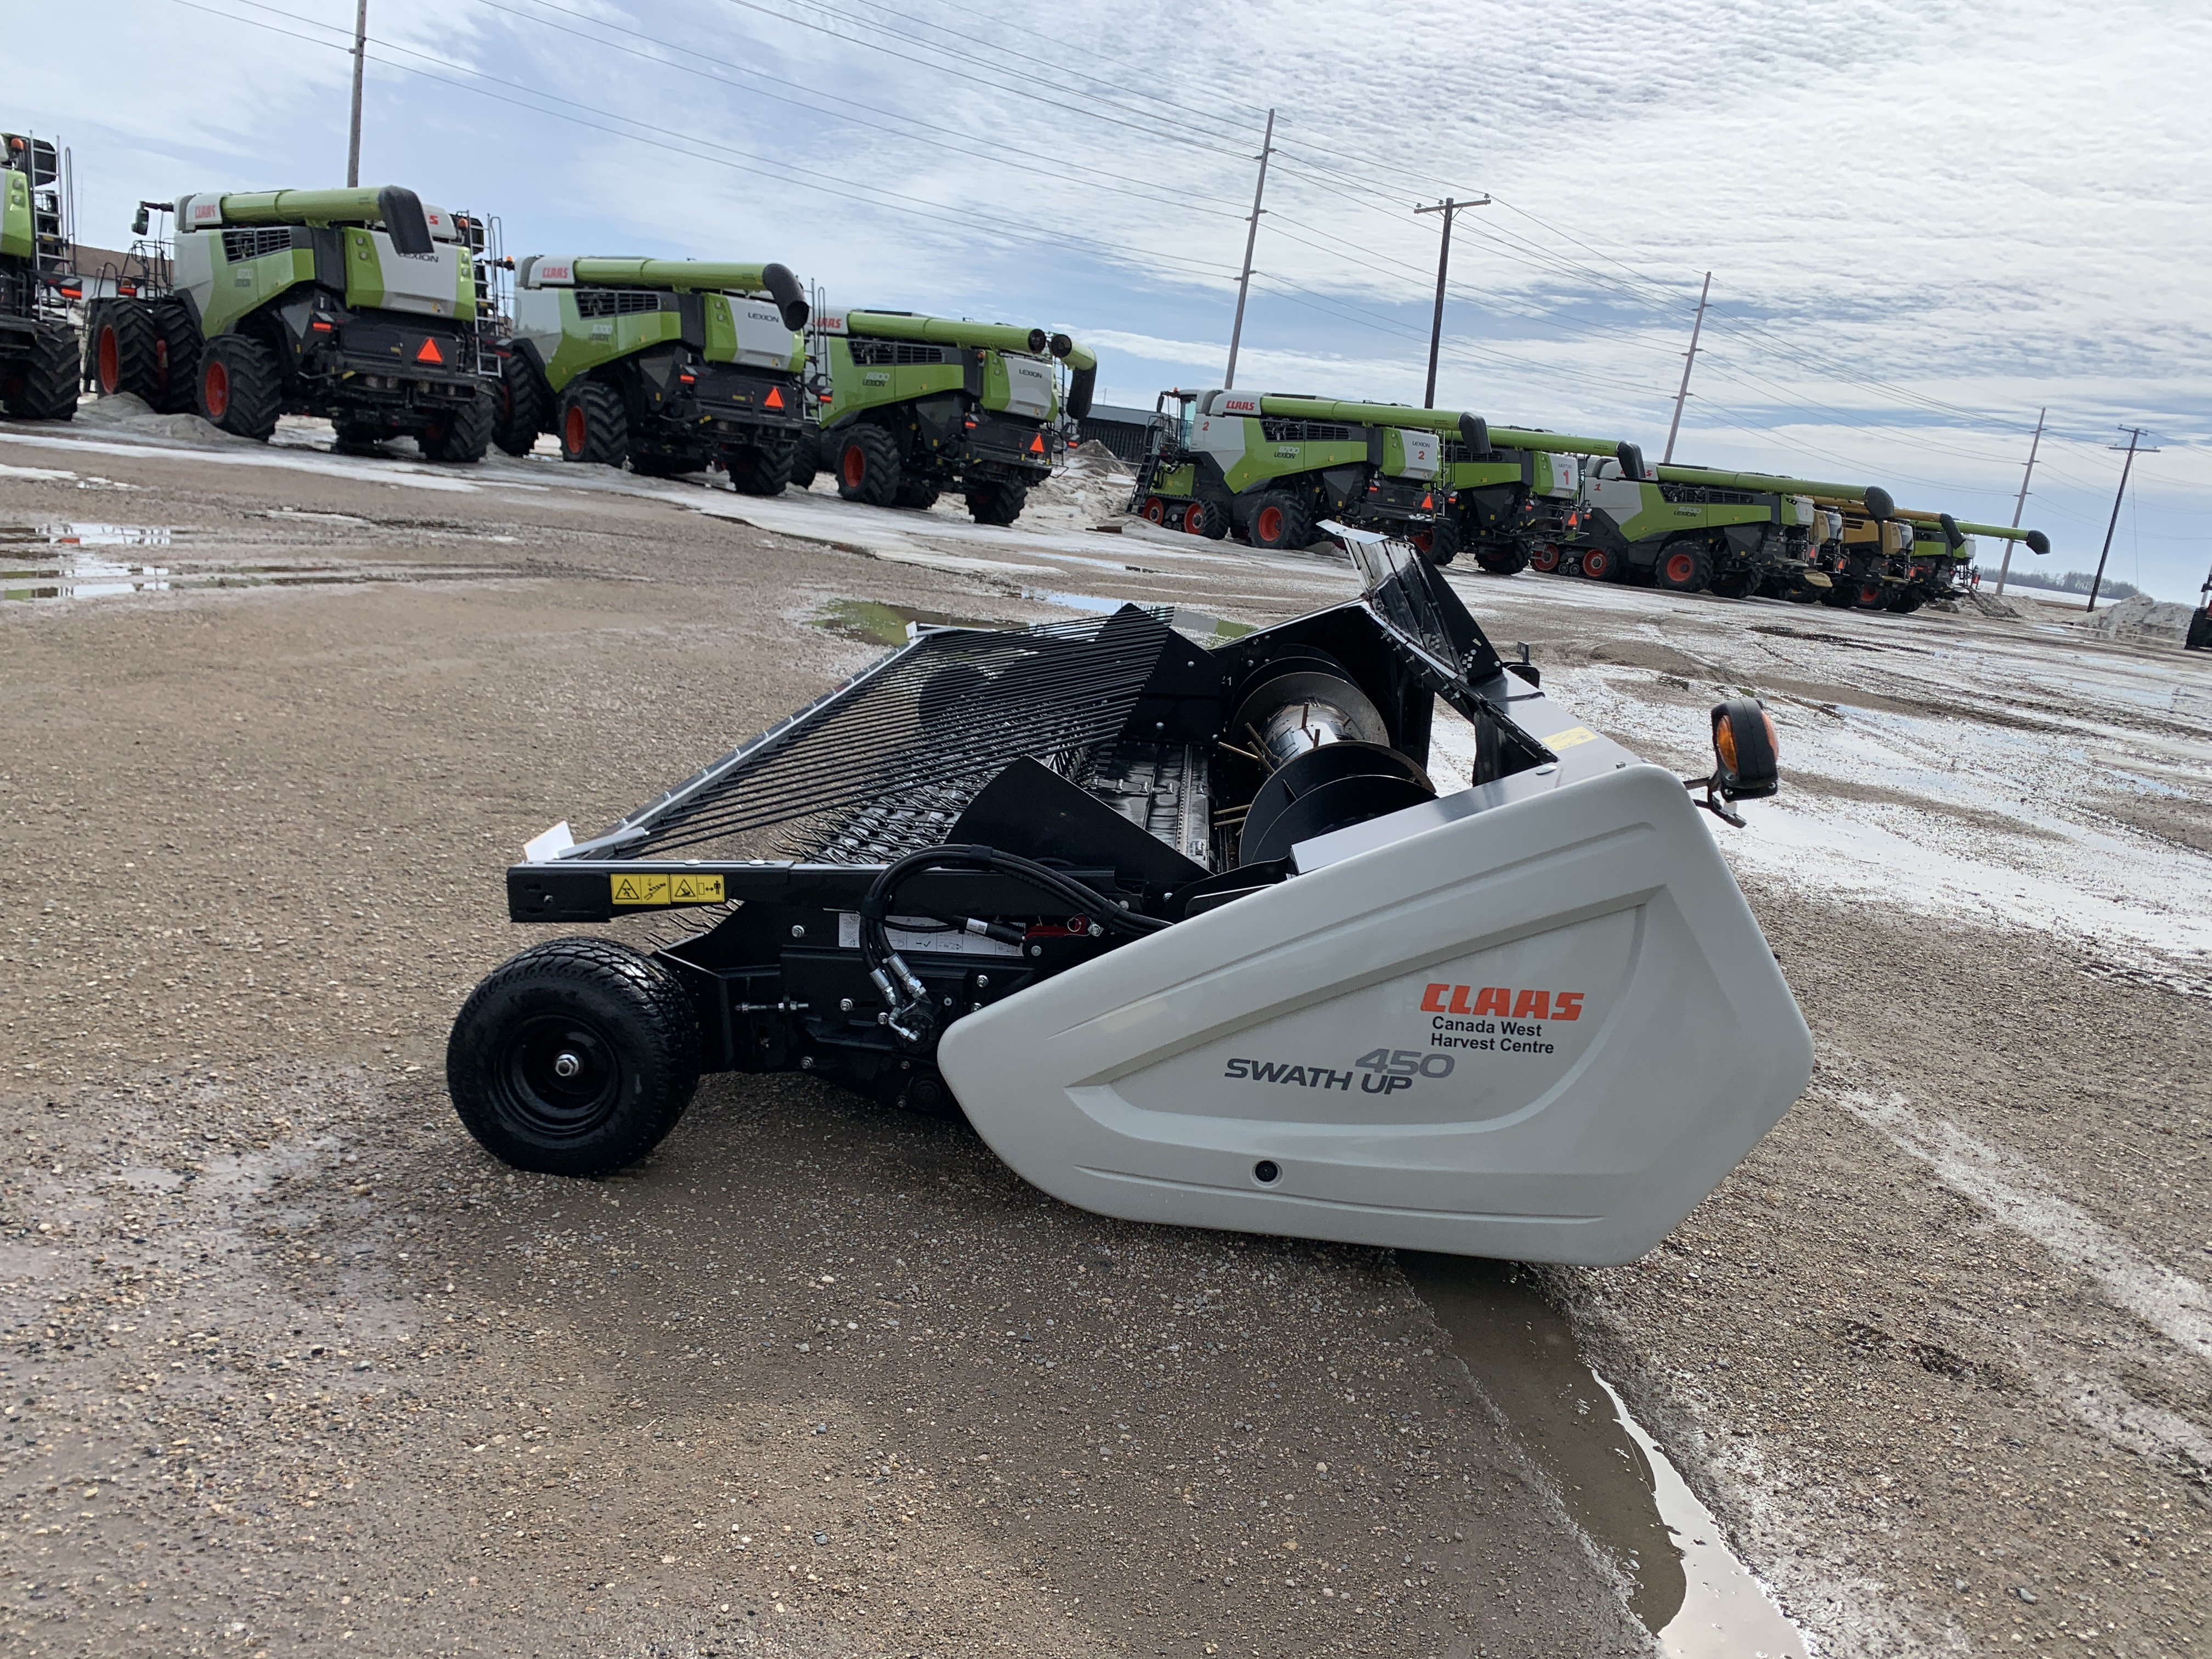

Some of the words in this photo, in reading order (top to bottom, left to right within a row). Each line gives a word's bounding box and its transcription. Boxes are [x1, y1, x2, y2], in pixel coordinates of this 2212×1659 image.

[542, 267, 568, 279] CLAAS
[747, 312, 780, 323] LEXION
[1226, 400, 1255, 411] CLAAS
[1202, 421, 1210, 431] 2
[1418, 450, 1425, 460] 2
[1563, 470, 1570, 485] 1
[1594, 483, 1601, 492] 1
[1420, 983, 1585, 1021] CLAAS
[1432, 1016, 1495, 1034] Canada
[1501, 1021, 1542, 1037] West
[1431, 1032, 1496, 1051] Harvest
[1500, 1038, 1555, 1054] Centre
[1355, 1048, 1455, 1079] 450
[1224, 1058, 1353, 1091] SWATH
[1361, 1073, 1413, 1096] UP
